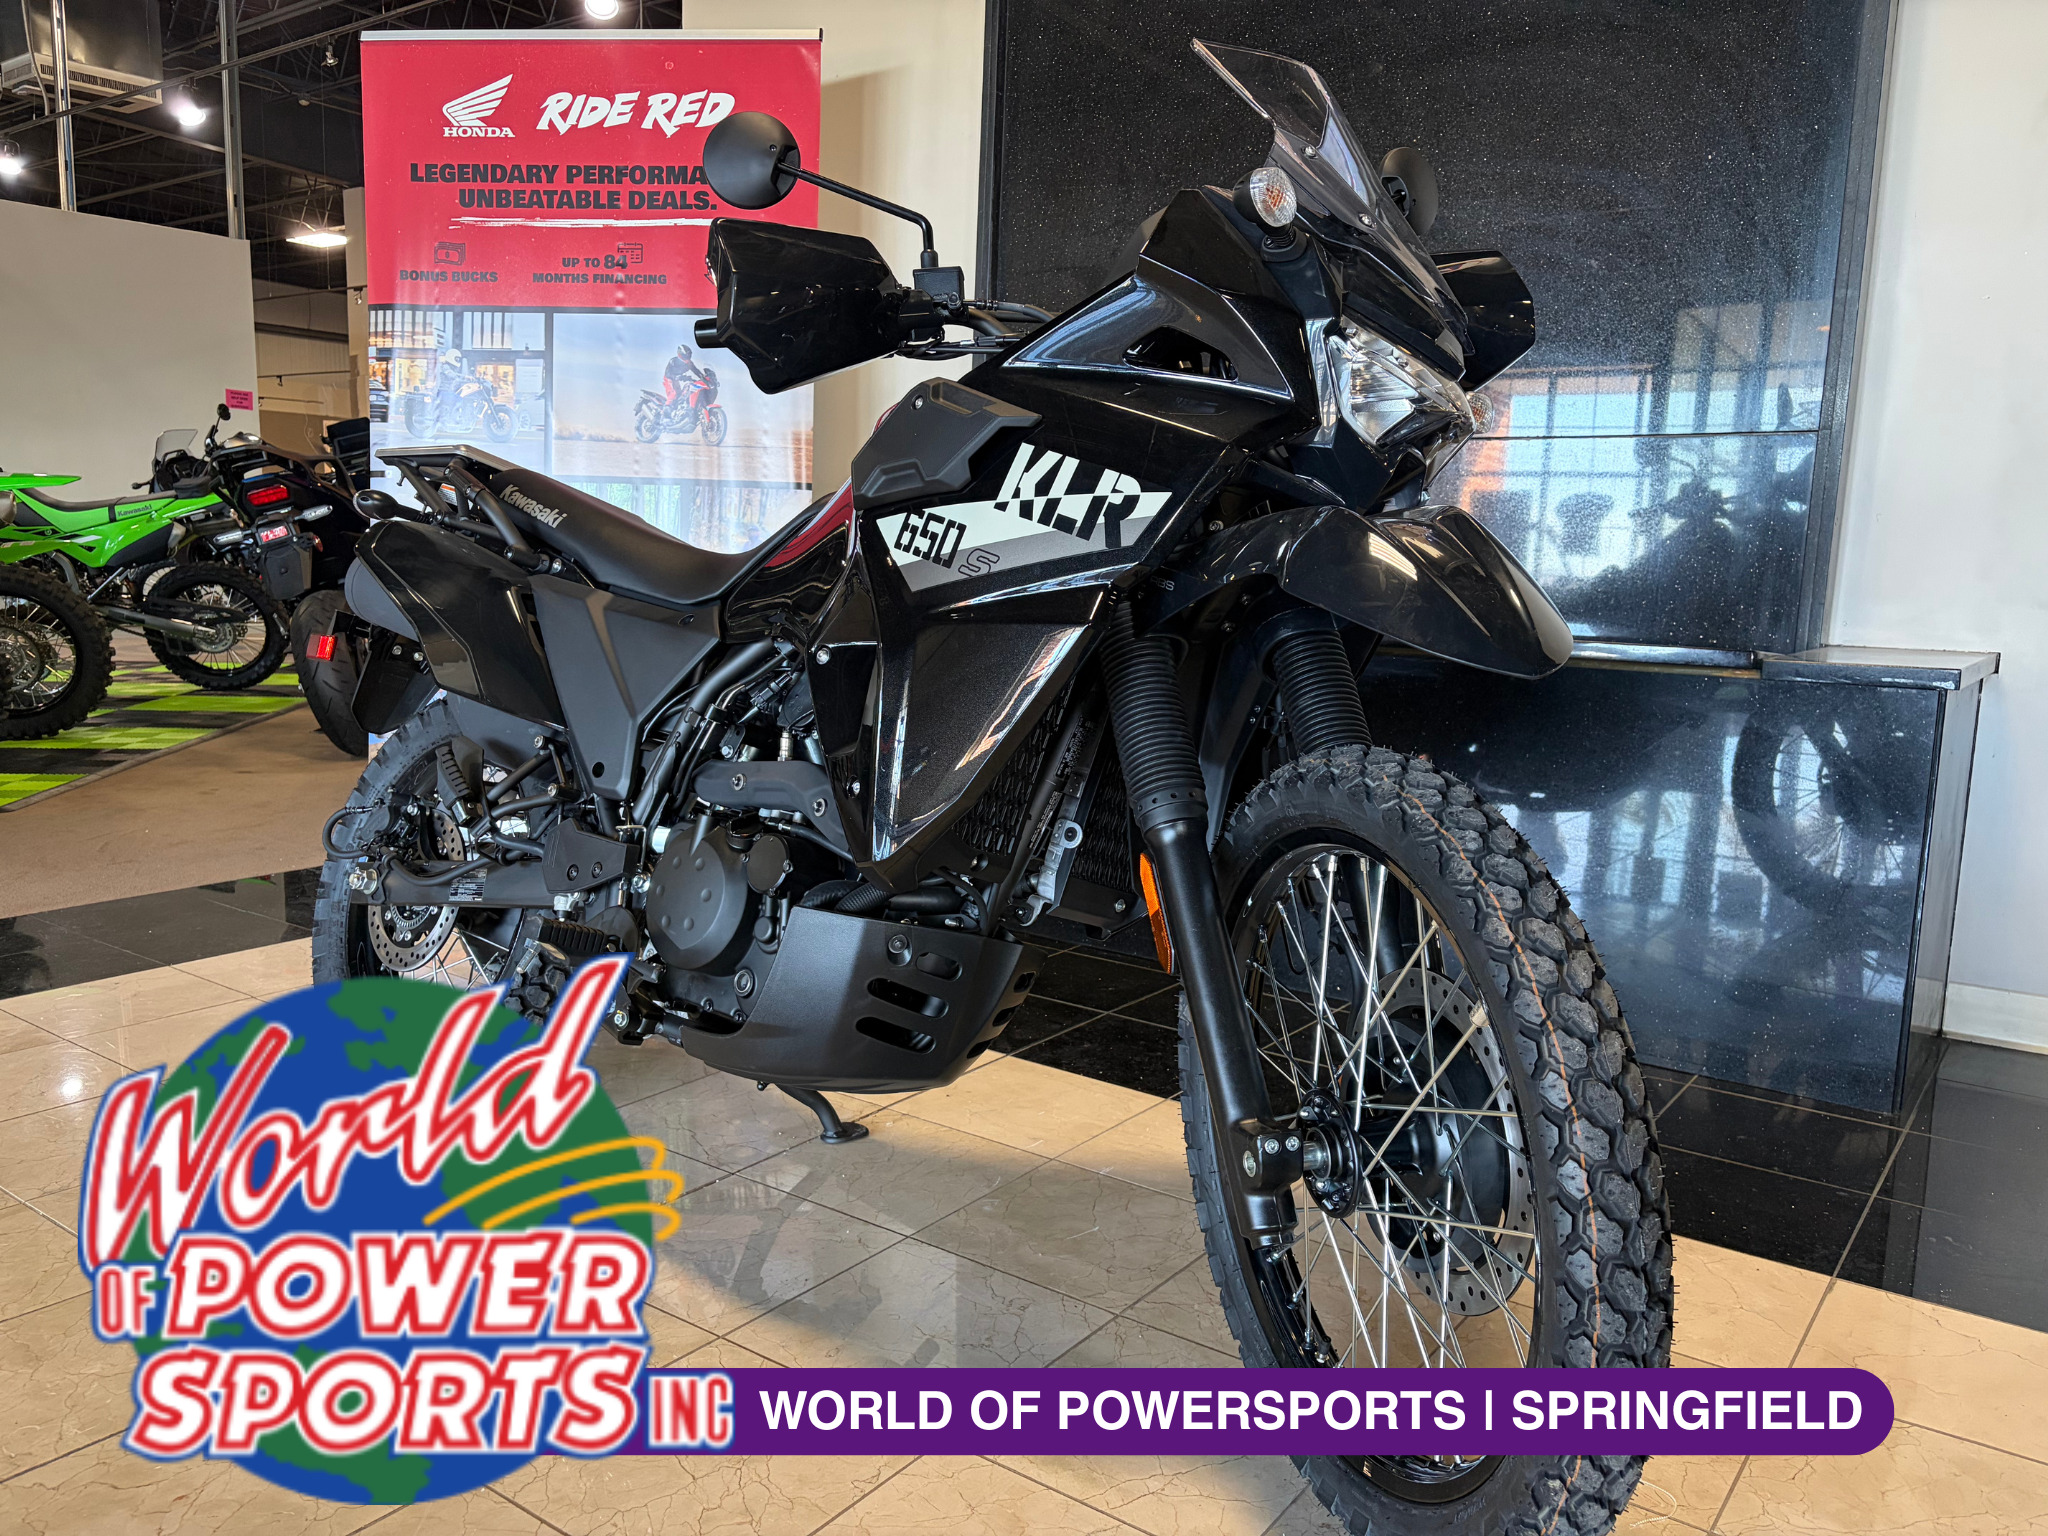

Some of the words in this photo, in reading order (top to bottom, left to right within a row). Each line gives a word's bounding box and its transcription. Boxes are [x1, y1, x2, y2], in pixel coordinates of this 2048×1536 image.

[536, 91, 640, 135] RIDE
[641, 89, 736, 138] RED
[442, 126, 516, 138] HONDA
[410, 163, 559, 184] LEGENDARY
[566, 165, 706, 185] PERFORMA
[458, 189, 621, 209] UNBEATABLE
[628, 190, 718, 211] DEALS.
[562, 257, 580, 268] UP
[584, 257, 600, 268] TO
[603, 254, 628, 270] 84
[399, 269, 448, 282] BONUS
[451, 271, 499, 283] BUCKS
[532, 273, 589, 284] MONTHS
[592, 274, 668, 285] FINANCING
[499, 484, 568, 529] Kawasaki
[994, 442, 1142, 549] KLR
[894, 509, 967, 569] 650
[958, 548, 1000, 577] S
